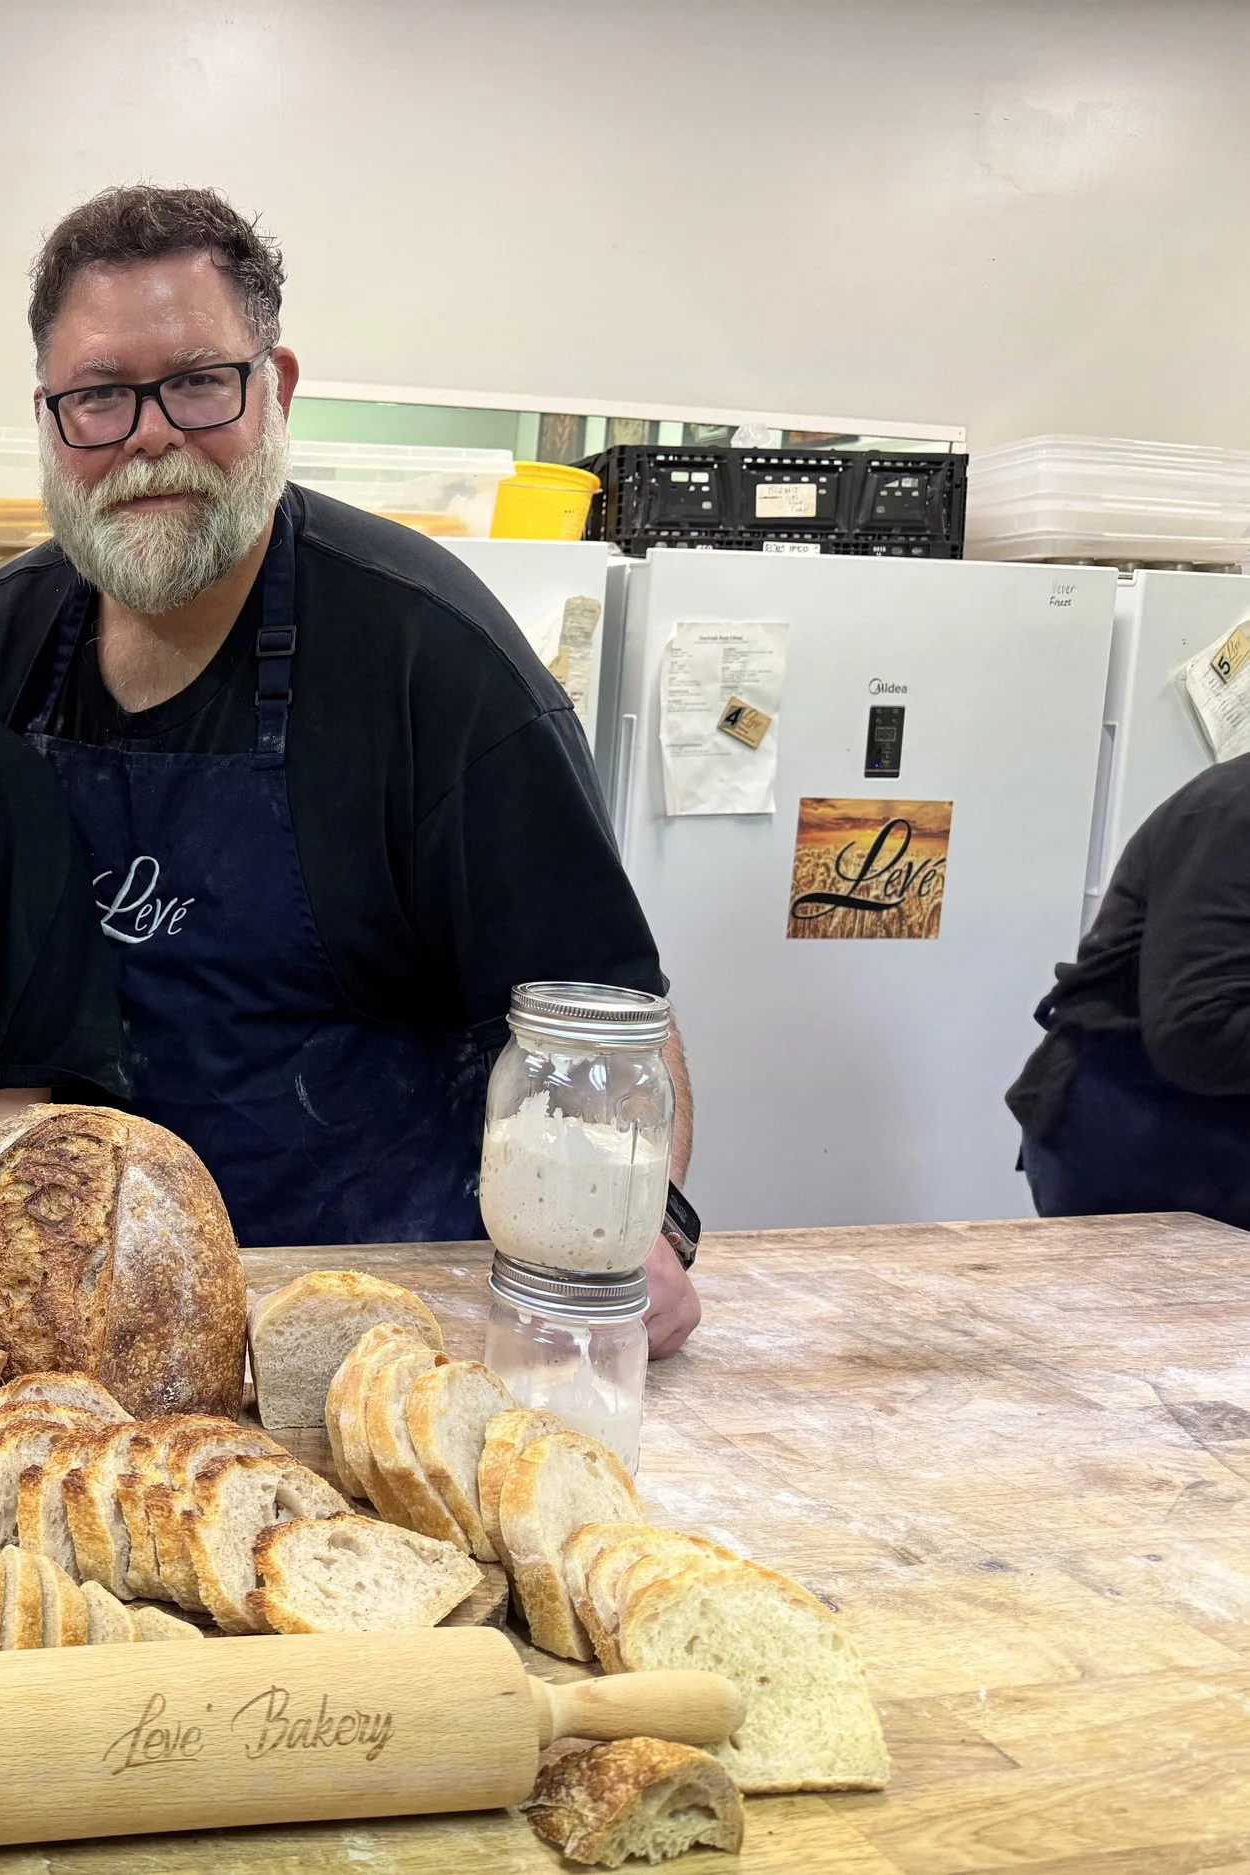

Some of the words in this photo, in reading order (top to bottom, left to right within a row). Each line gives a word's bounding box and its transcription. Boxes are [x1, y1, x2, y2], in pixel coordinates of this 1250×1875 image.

[868, 677, 908, 695] Midea
[1218, 656, 1231, 675] 5
[725, 706, 743, 726] 4
[791, 818, 947, 920] Levé
[92, 855, 195, 944] Levé
[231, 1684, 395, 1762] Bakery
